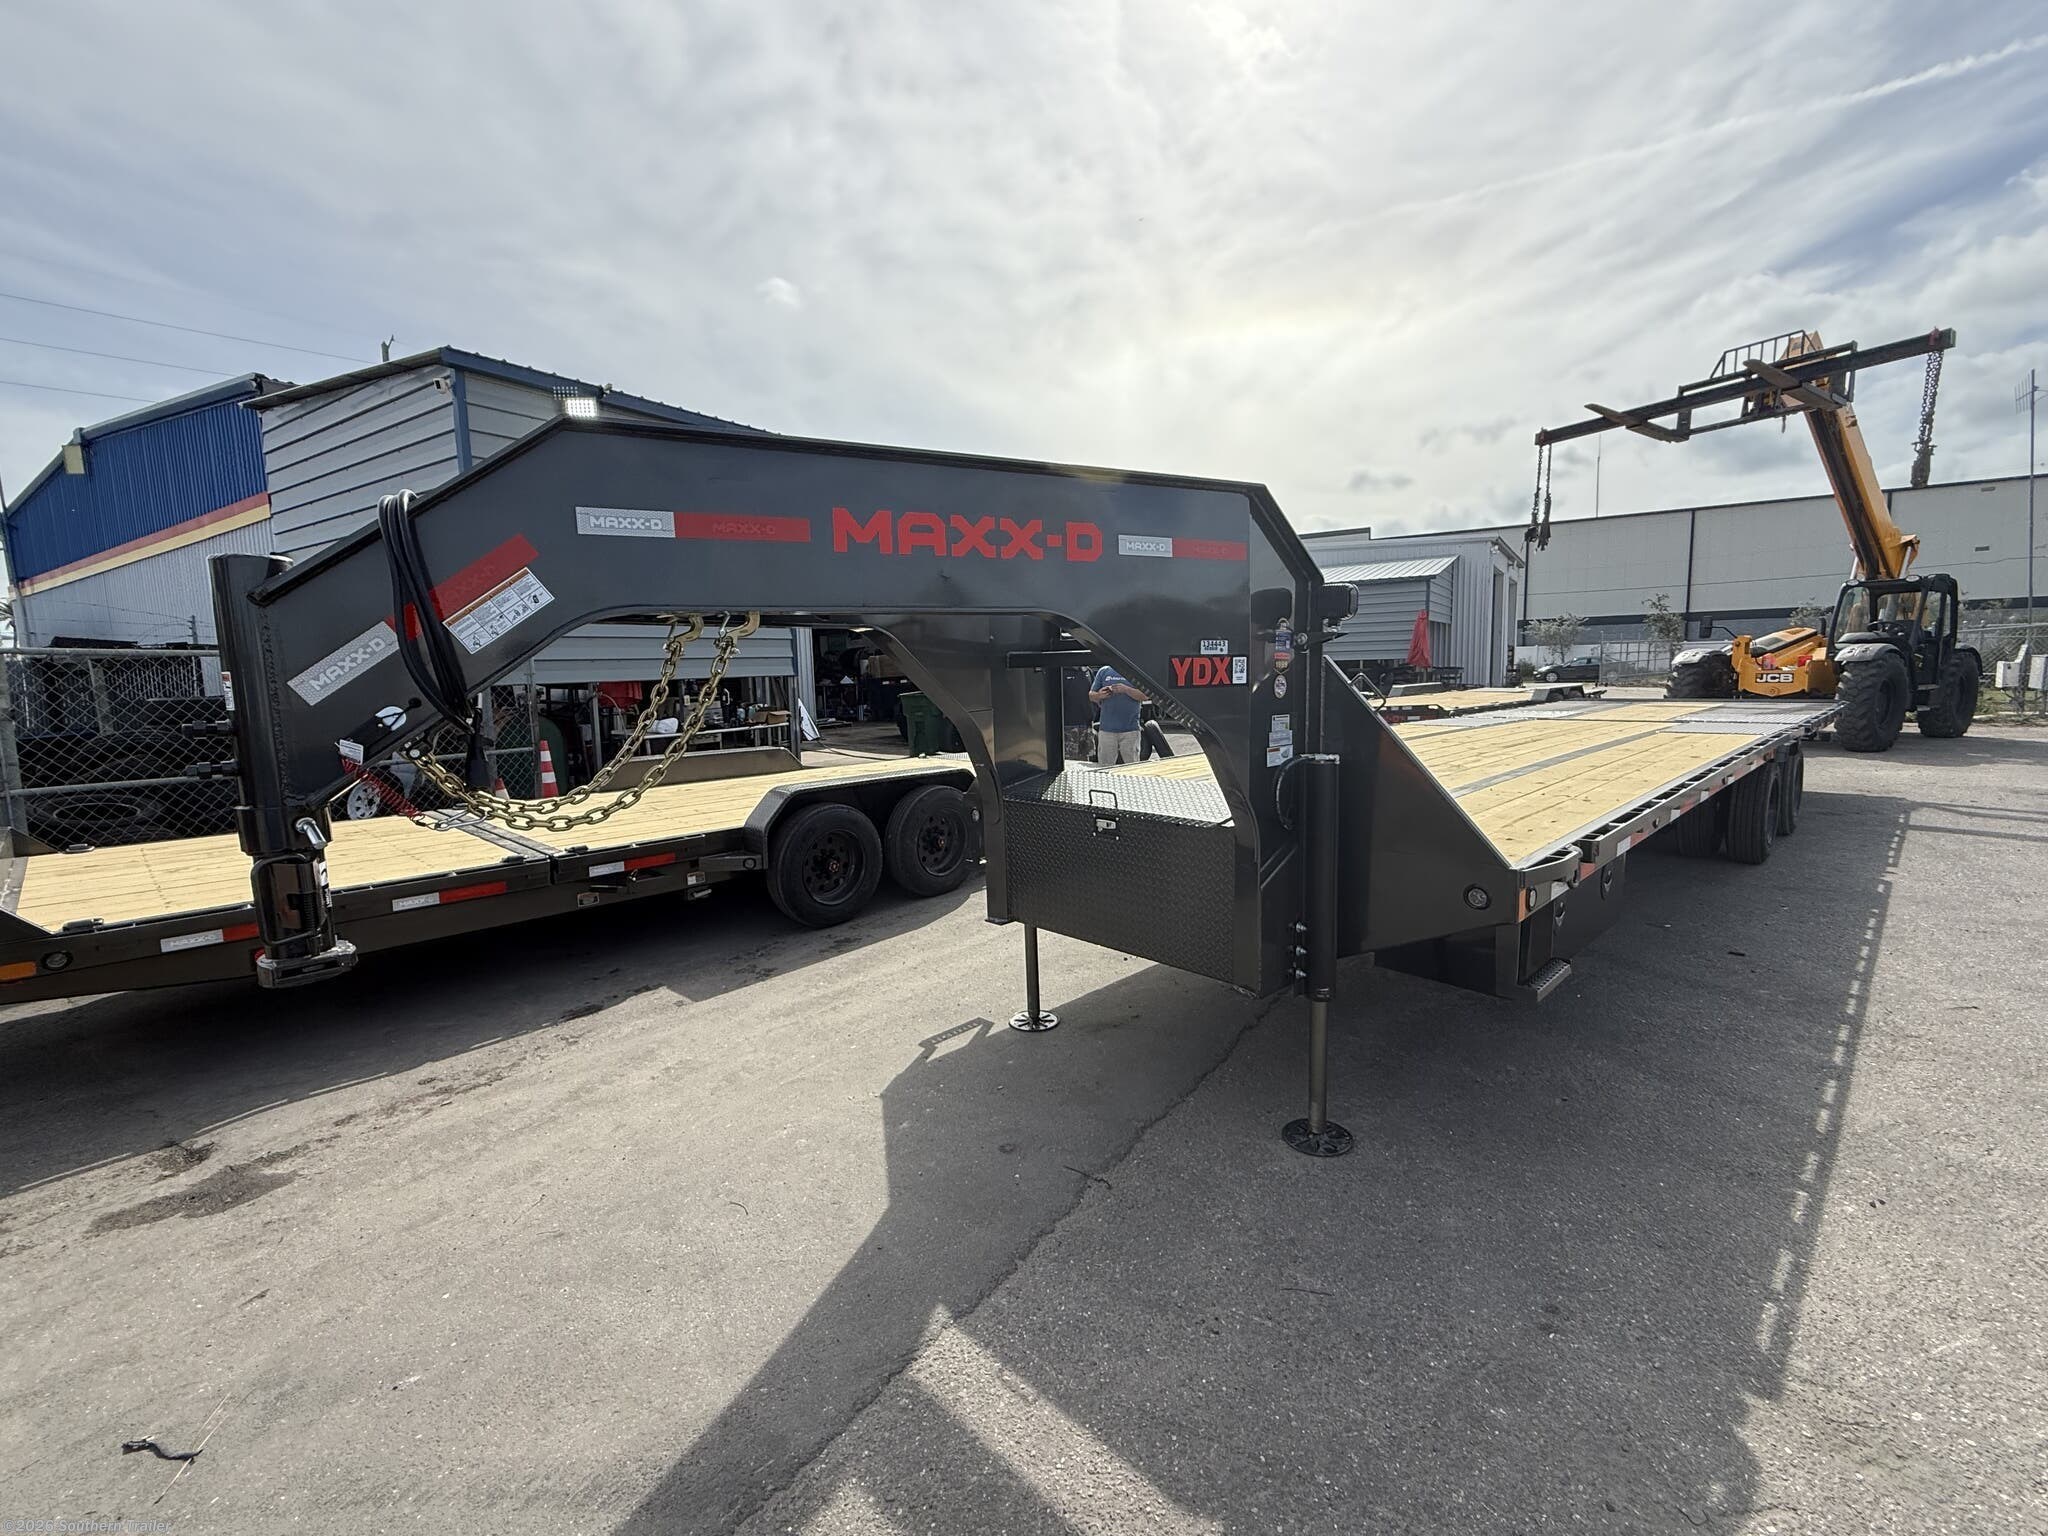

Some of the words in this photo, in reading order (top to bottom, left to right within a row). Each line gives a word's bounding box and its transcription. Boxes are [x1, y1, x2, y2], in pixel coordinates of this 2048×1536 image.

[589, 515, 662, 530] MAXX-D
[712, 520, 776, 535] MAXX-D
[832, 506, 1103, 562] MAXX-D
[1126, 541, 1166, 552] MAXX-D
[308, 637, 386, 691] MAXX-D
[1171, 656, 1231, 686] YDX
[1756, 673, 1793, 683] JCB
